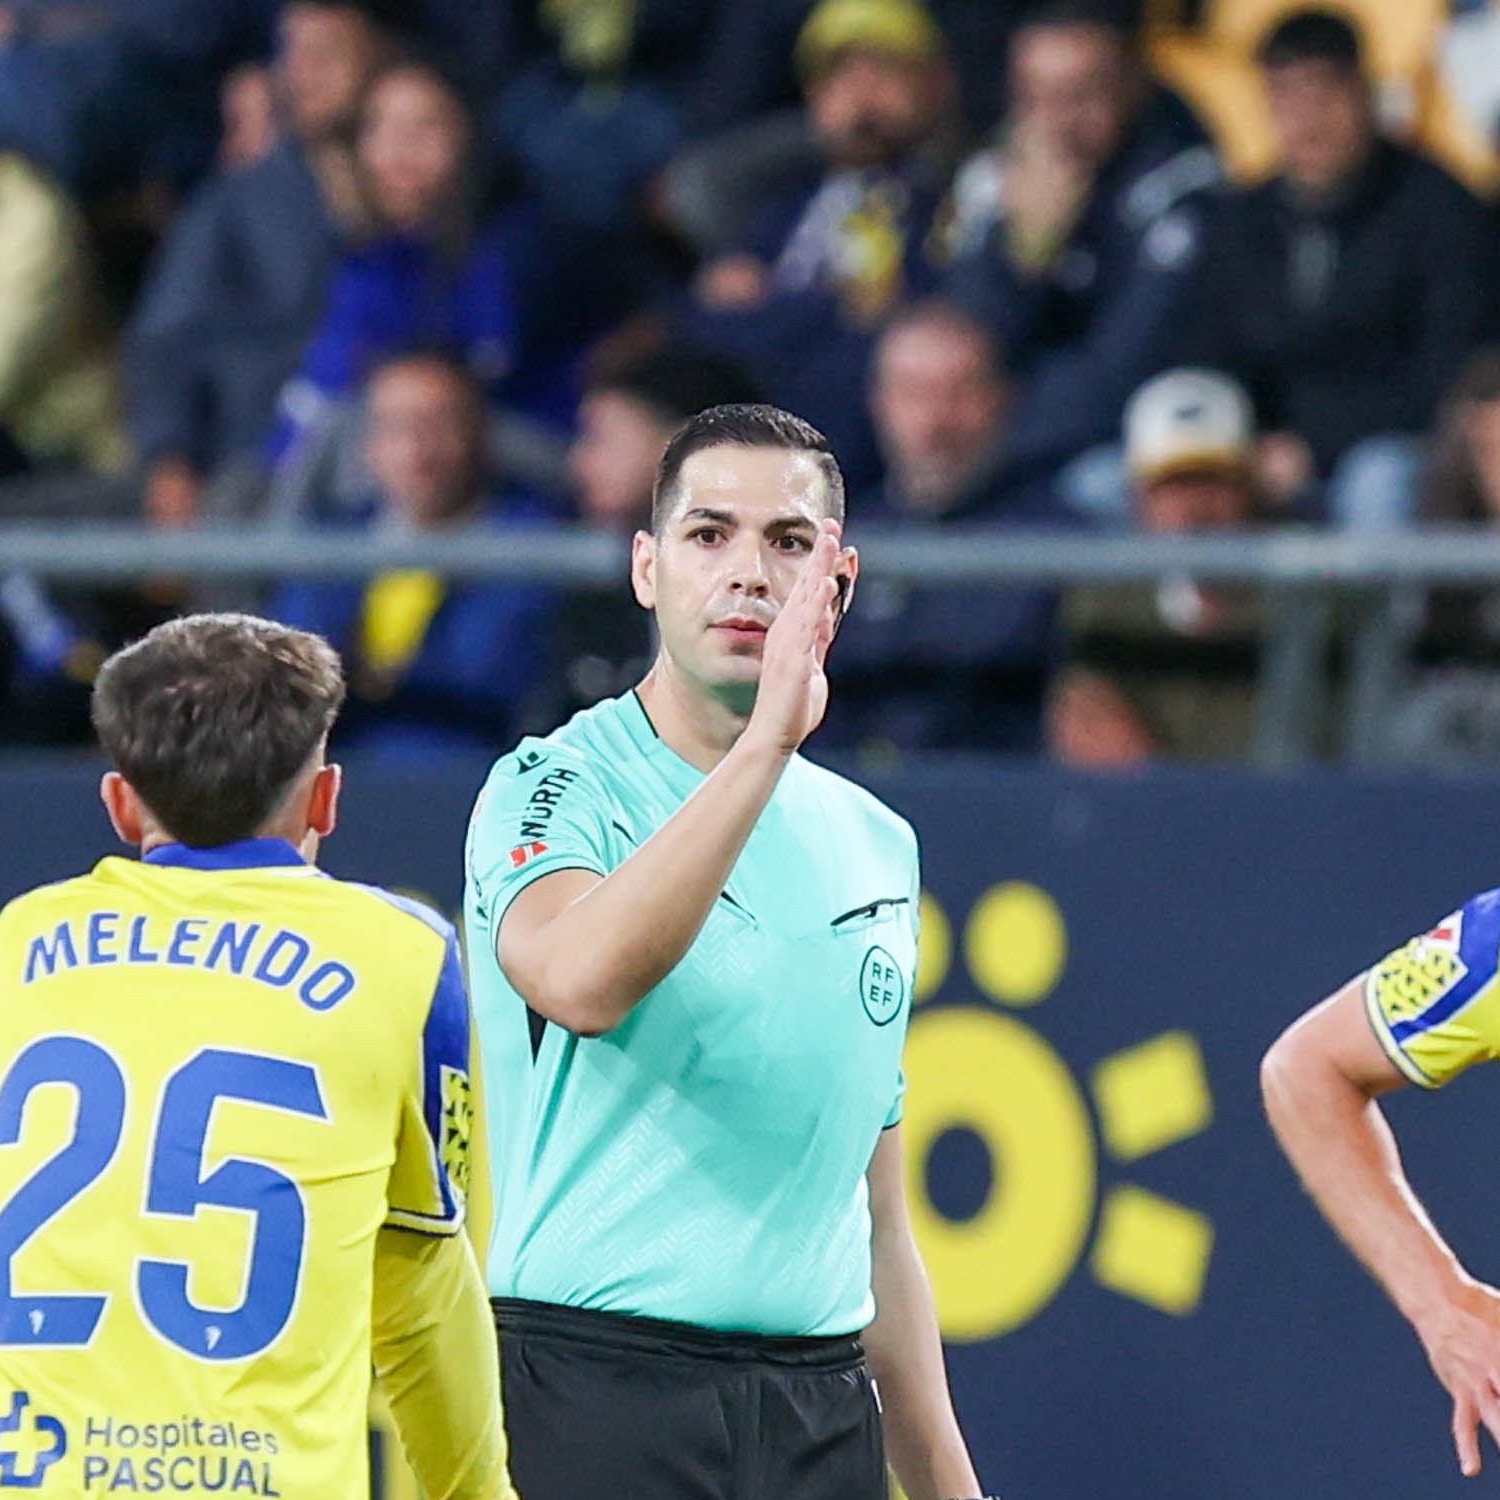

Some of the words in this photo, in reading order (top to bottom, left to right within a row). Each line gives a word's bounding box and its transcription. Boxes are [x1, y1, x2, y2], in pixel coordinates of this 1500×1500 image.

[21, 911, 357, 1013] MELENDO
[83, 1414, 280, 1457] Hospitales
[83, 1455, 282, 1498] PASCUAL
